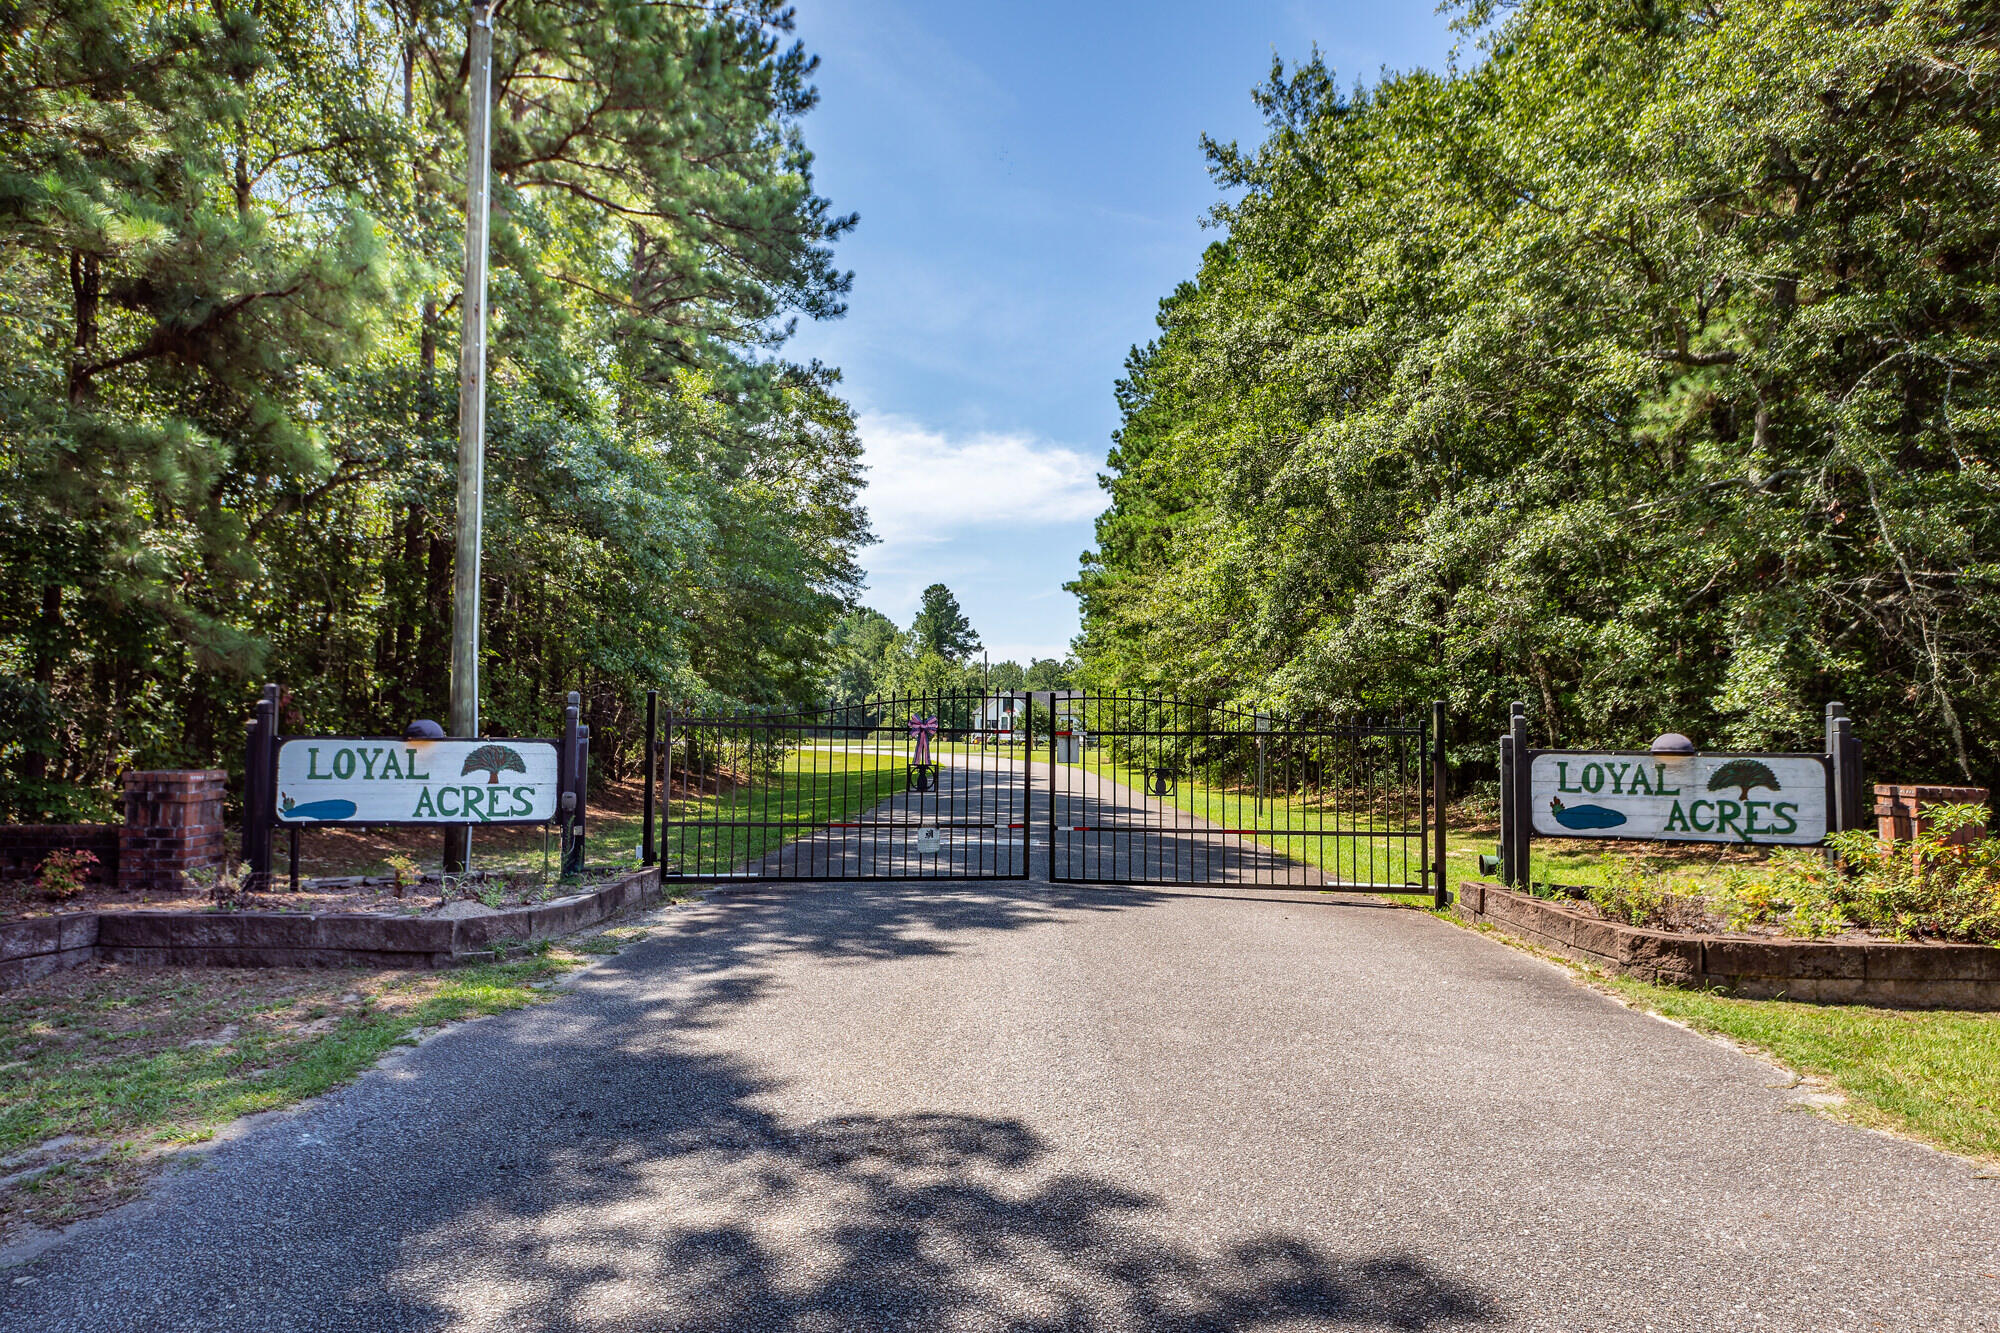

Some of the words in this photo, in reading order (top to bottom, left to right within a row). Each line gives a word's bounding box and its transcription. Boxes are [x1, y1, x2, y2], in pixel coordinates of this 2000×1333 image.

[307, 747, 430, 780] LOYAL
[1557, 761, 1680, 796] LOYAL
[412, 786, 536, 822] ACRES
[1664, 799, 1799, 842] ACRES
